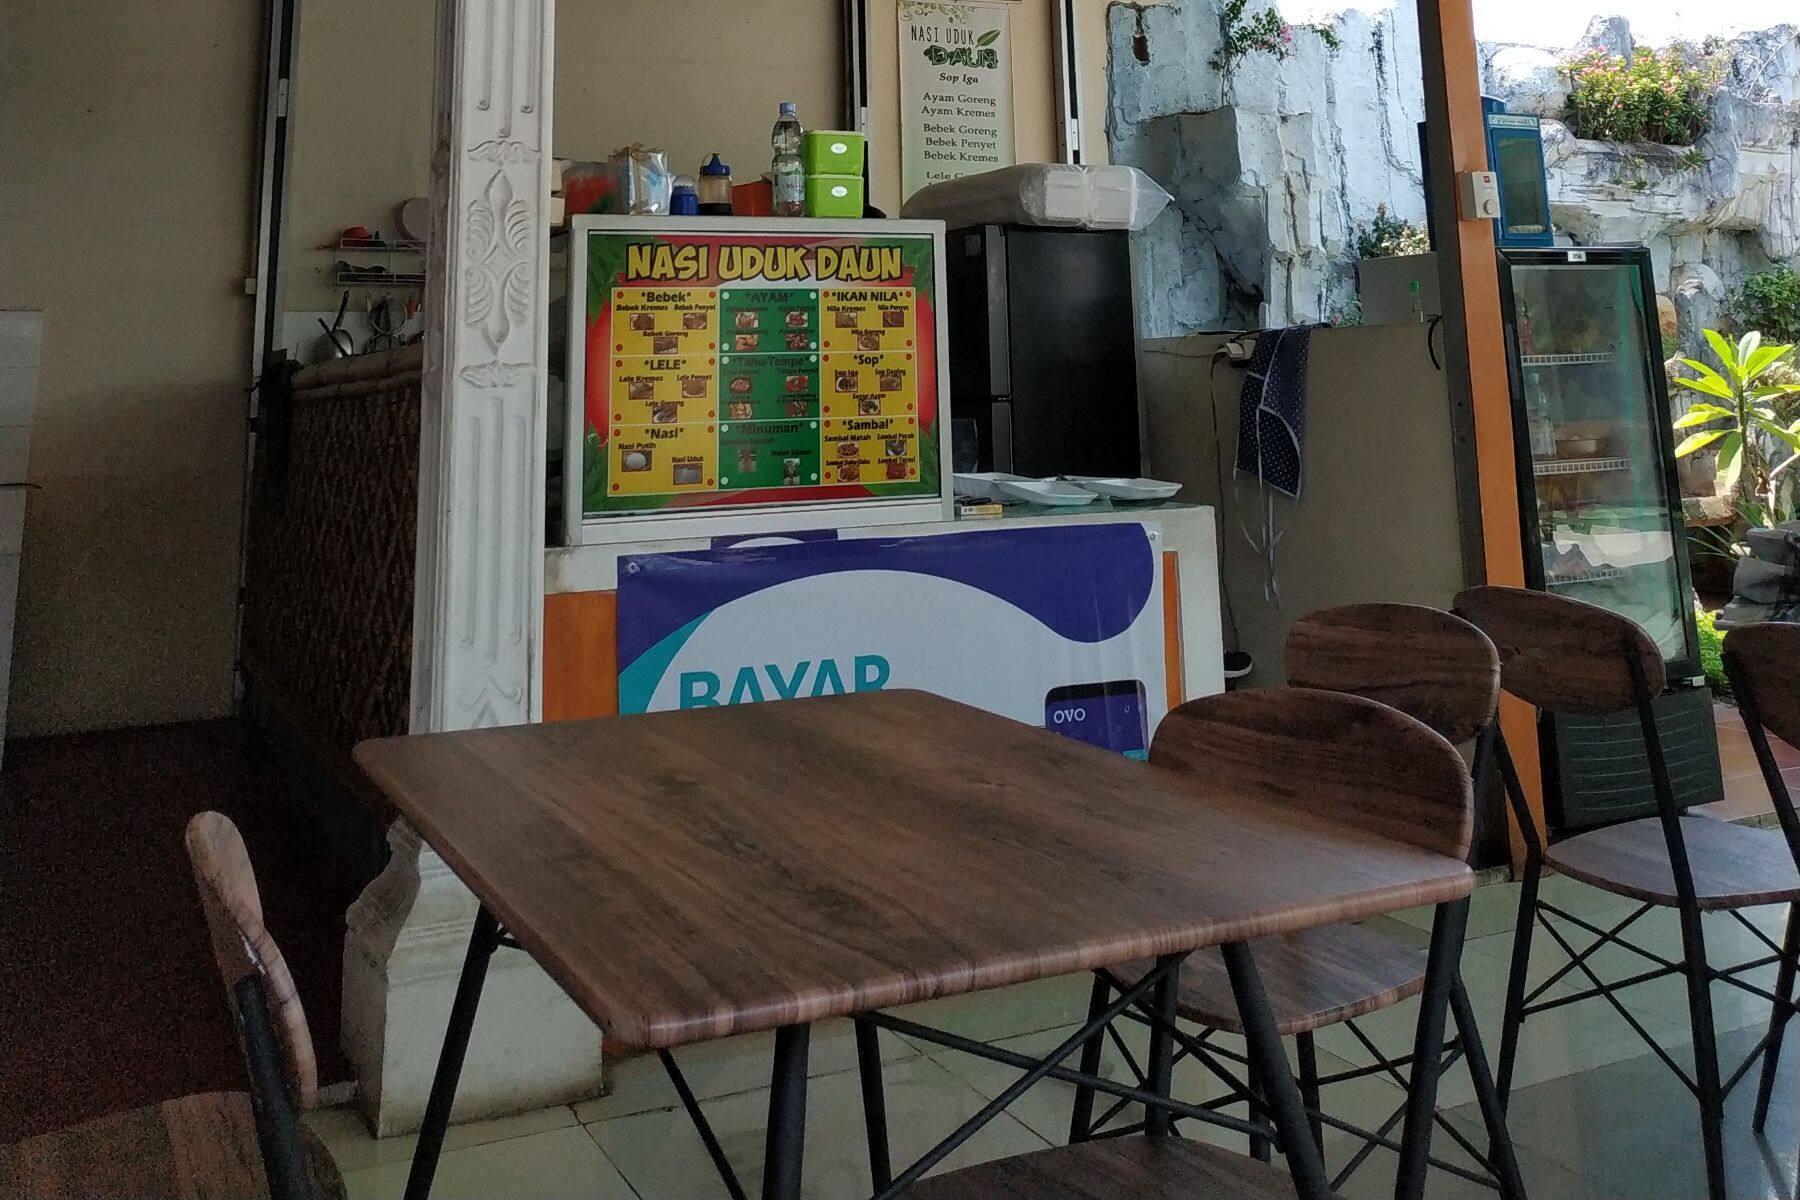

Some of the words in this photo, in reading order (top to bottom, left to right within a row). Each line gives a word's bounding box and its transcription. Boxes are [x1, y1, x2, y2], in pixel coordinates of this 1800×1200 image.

[911, 25, 939, 43] NASI
[946, 28, 974, 46] UDUK
[929, 45, 998, 69] DAUN
[939, 72, 959, 84] Sop
[962, 74, 979, 85] Iga
[923, 92, 954, 103] Ayam
[957, 94, 996, 107] Goreng
[921, 105, 953, 117] Ayam
[956, 107, 996, 118] Kremes
[923, 123, 956, 133] Bebek
[958, 125, 998, 138] Goreng
[925, 137, 958, 147] Bebek
[961, 139, 997, 151] Penyet
[924, 150, 957, 160] Bebek
[959, 152, 999, 163] Kremes
[926, 171, 951, 179] Lele
[626, 242, 709, 282] NASI
[718, 244, 811, 282] UDUK
[815, 244, 903, 283] DAUN
[616, 303, 640, 312] Bebek
[680, 654, 891, 711] BAYAR
[1053, 707, 1086, 724] OVO
